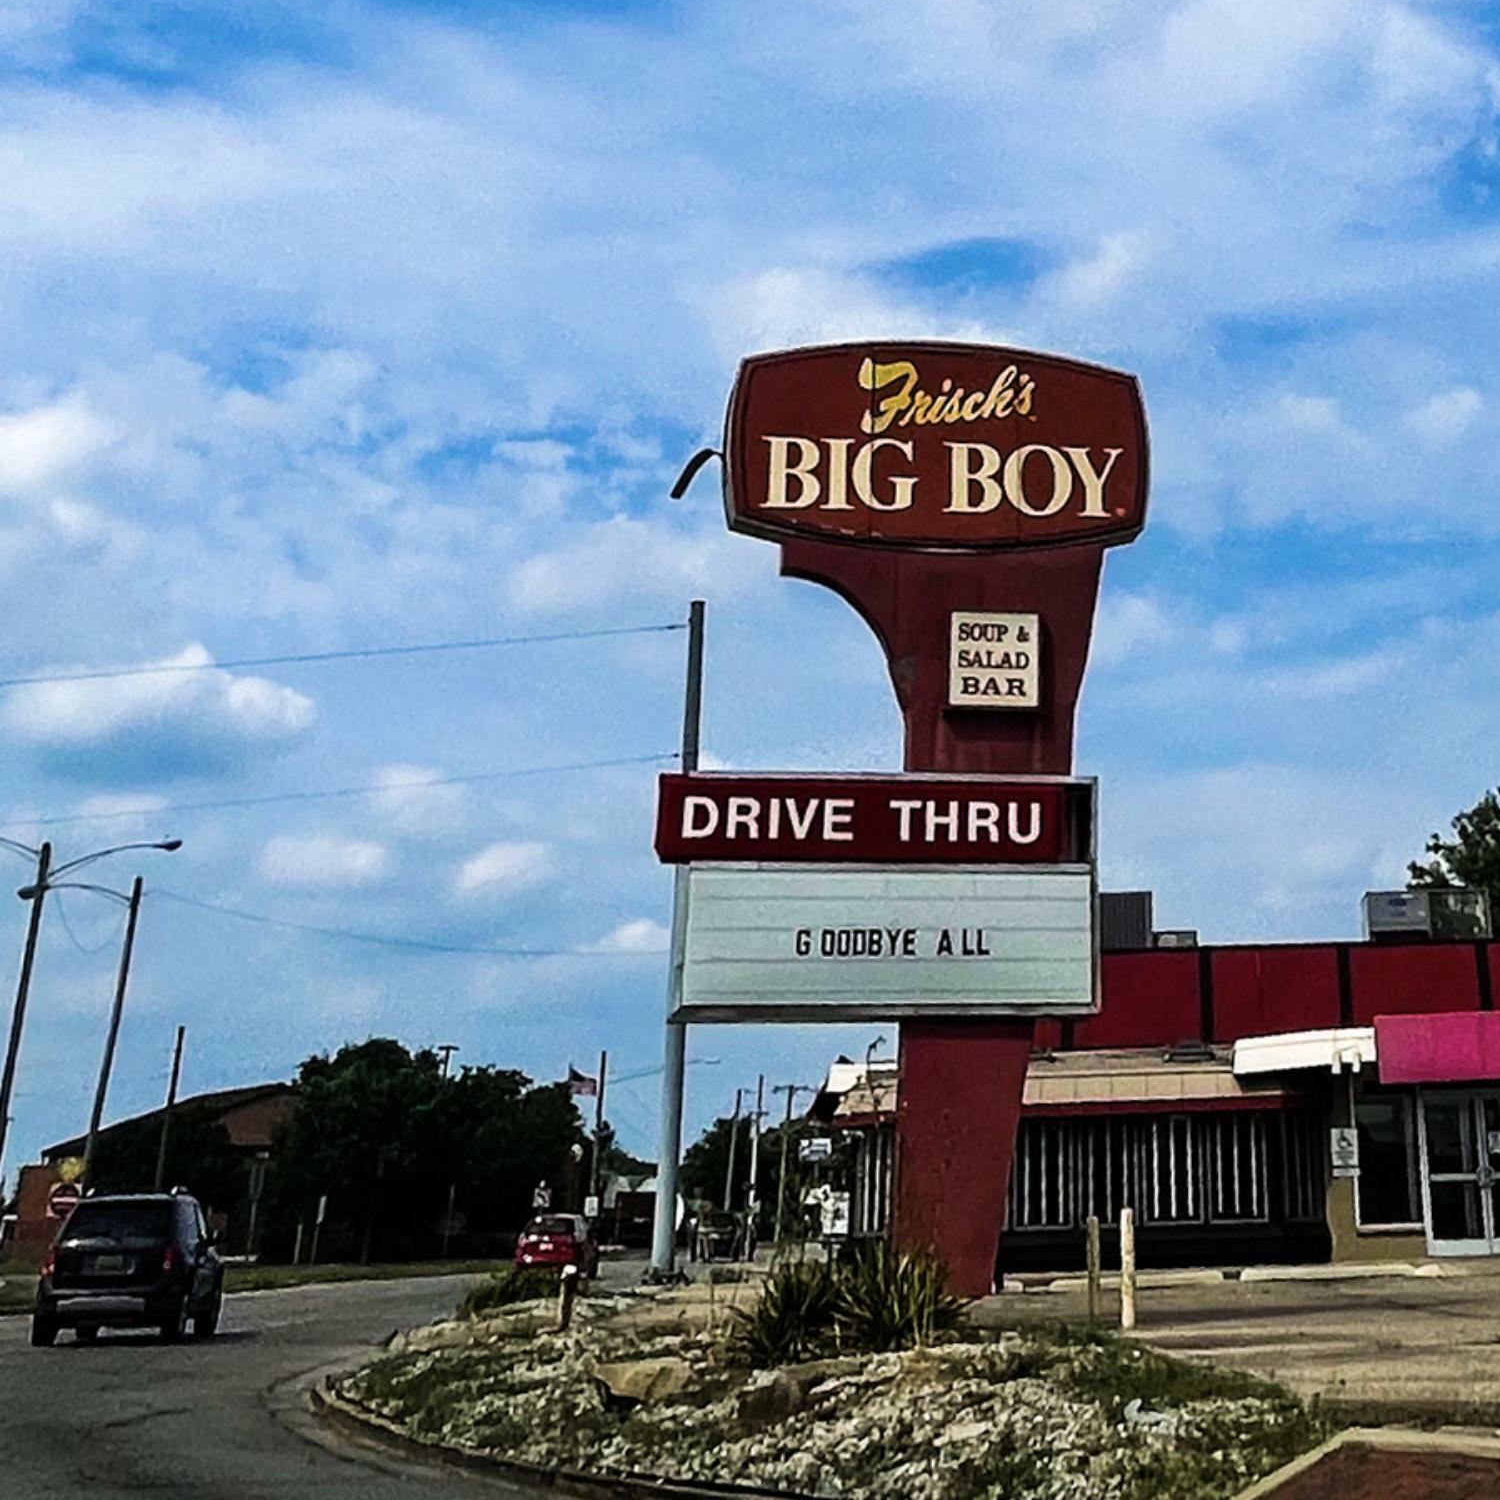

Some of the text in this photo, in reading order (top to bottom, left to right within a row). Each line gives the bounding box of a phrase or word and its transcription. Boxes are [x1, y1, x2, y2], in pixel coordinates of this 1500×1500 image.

[858, 357, 1036, 434] Frisch's
[759, 435, 1123, 518] BIG BOY
[958, 622, 1030, 642] SOUP &
[957, 649, 1030, 669] SALAD
[960, 676, 1027, 697] BAR
[681, 796, 1042, 844] DRIVE THRU
[795, 927, 991, 957] GOODBYE ALL
